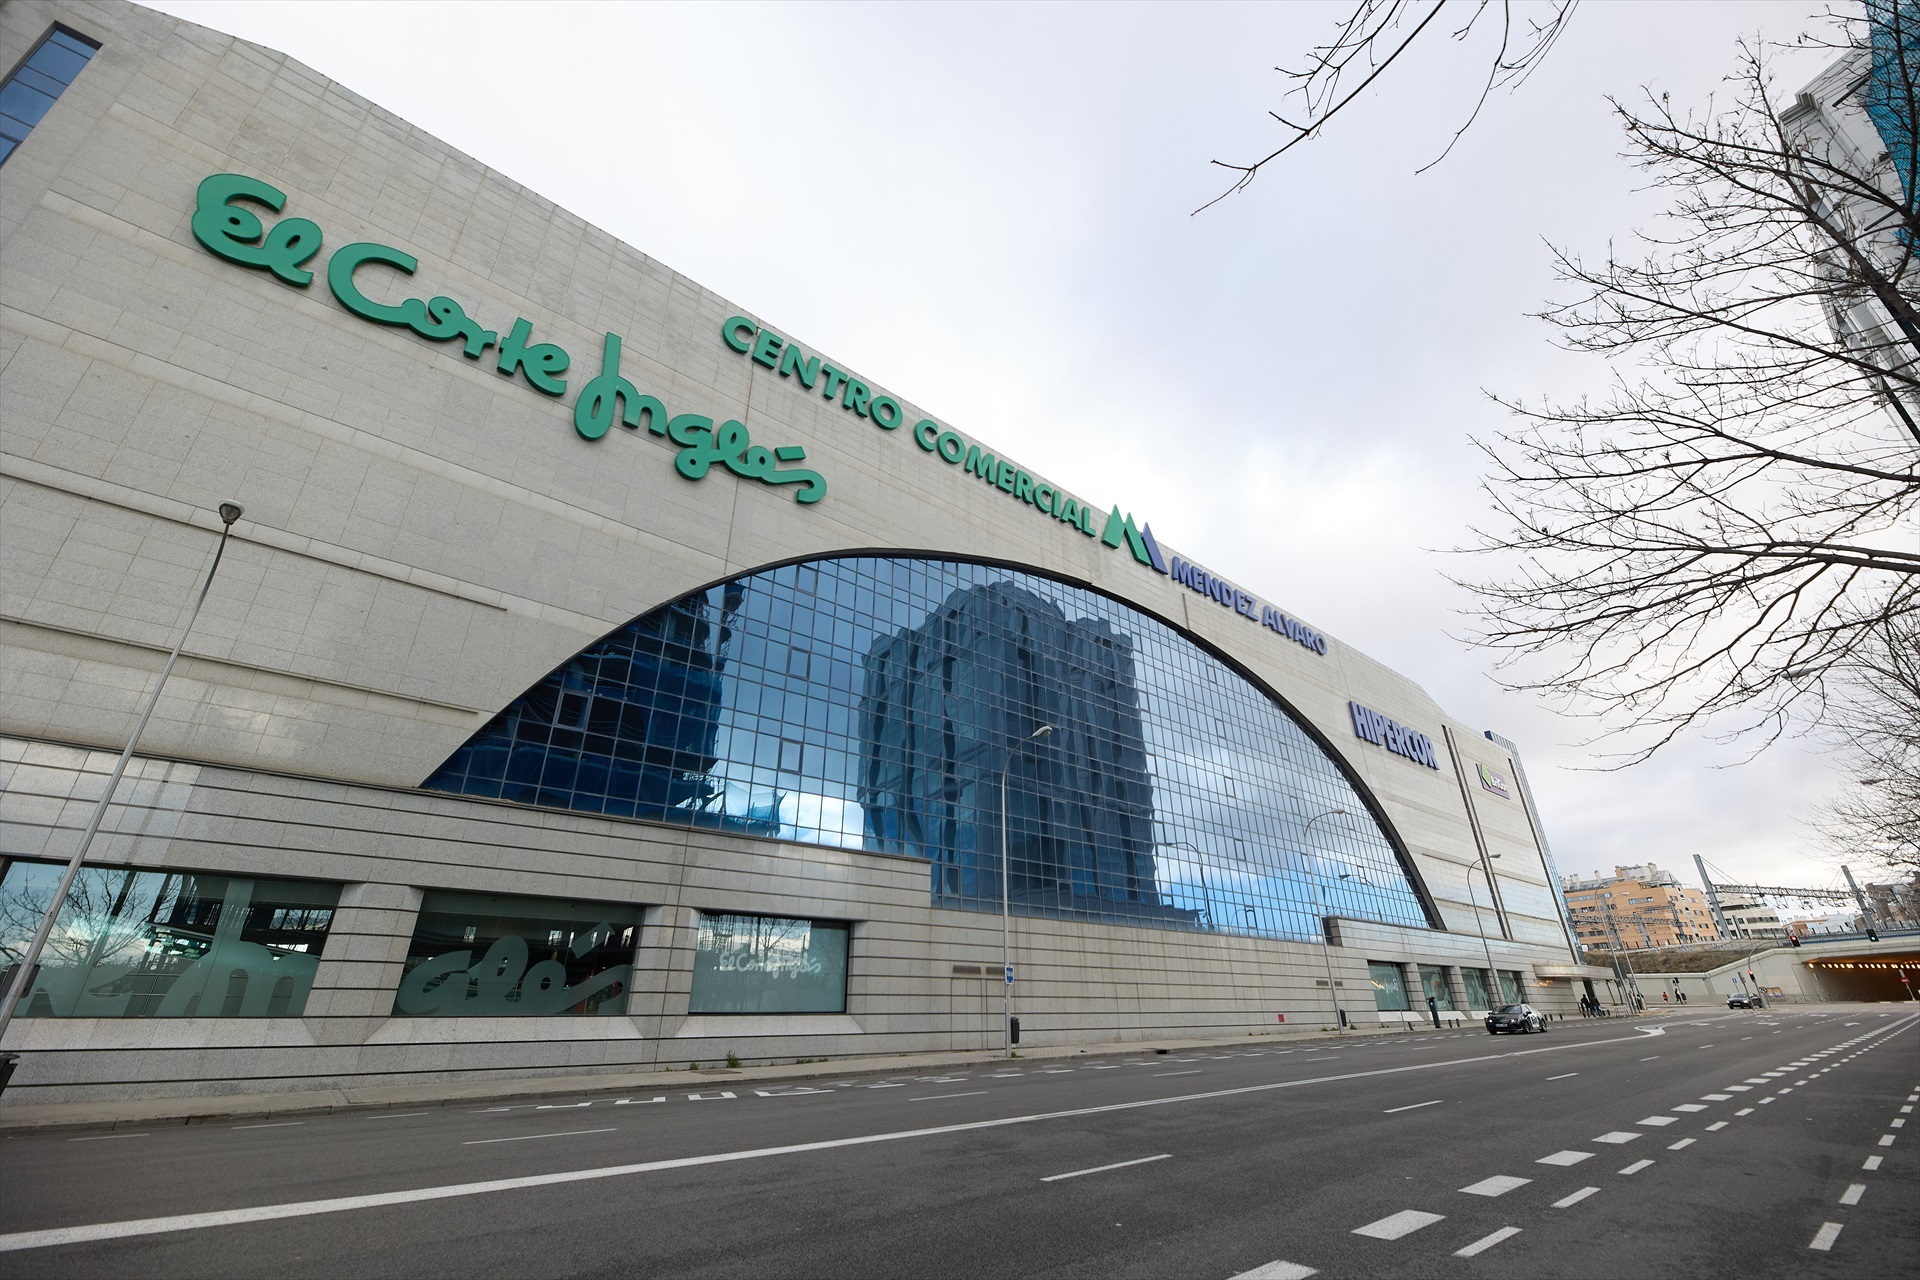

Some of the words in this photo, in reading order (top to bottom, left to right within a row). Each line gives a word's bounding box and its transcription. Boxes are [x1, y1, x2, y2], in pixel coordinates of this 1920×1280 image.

[191, 173, 323, 287] El
[327, 242, 571, 396] Corte
[574, 332, 828, 504] Inglés
[722, 315, 904, 431] CENTRO
[914, 418, 1097, 538] COMERCIAL
[1171, 555, 1260, 622] MENDEZ
[1262, 605, 1328, 656] ALVARO
[1348, 700, 1440, 771] HIPERCOR
